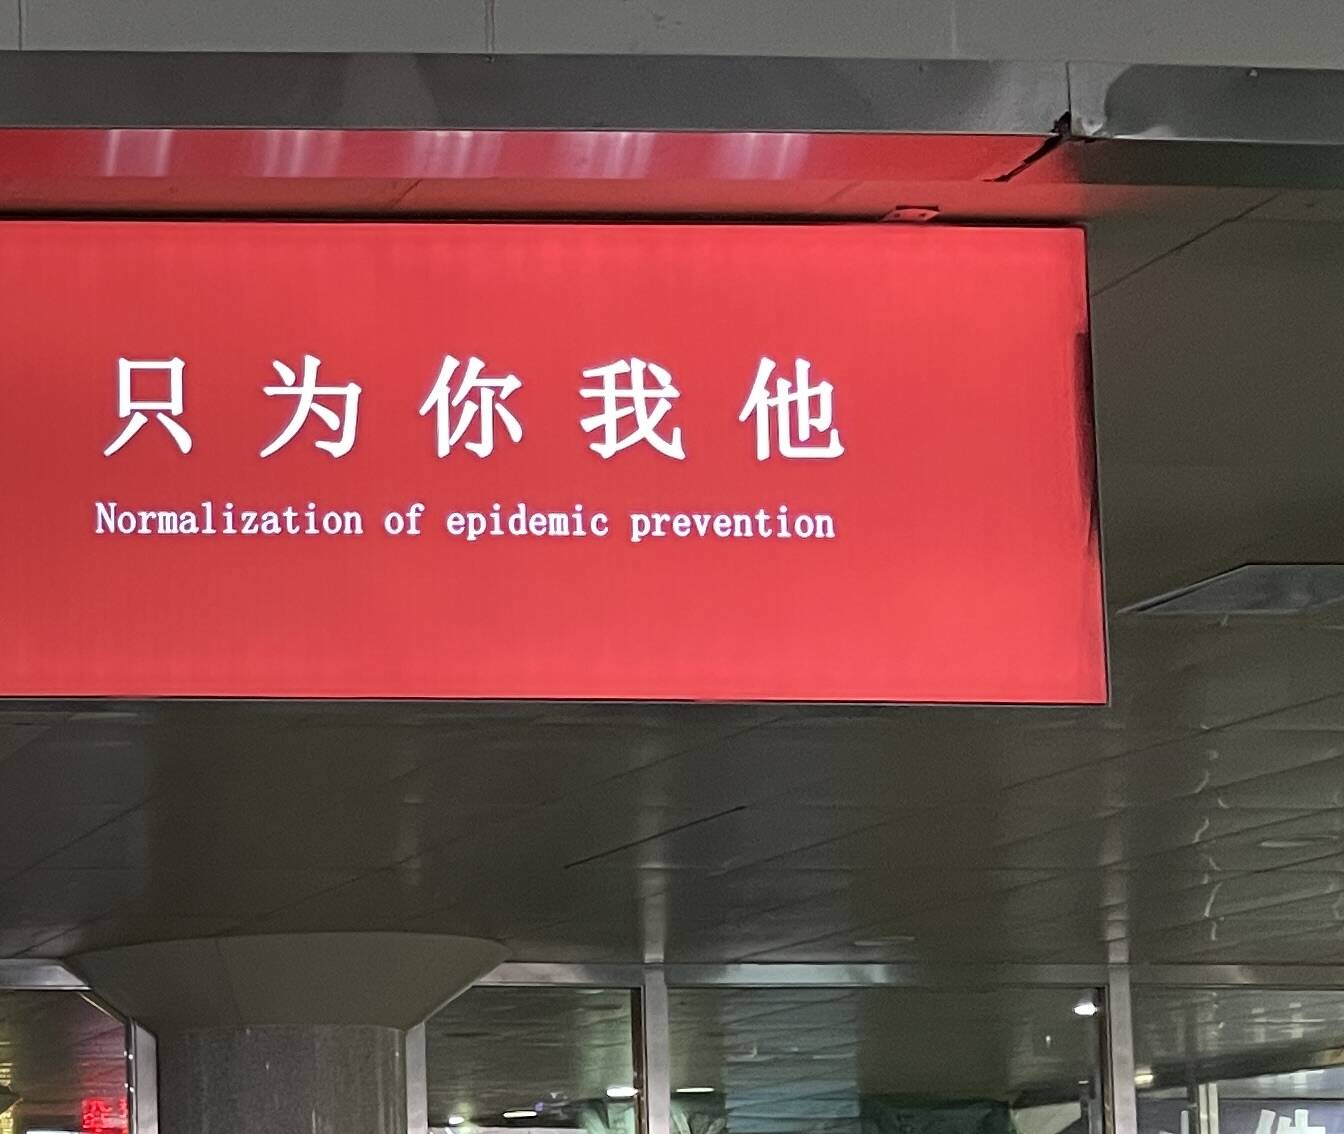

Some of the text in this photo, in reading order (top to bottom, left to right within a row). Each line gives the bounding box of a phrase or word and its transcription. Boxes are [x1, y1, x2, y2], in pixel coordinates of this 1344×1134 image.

[102, 353, 846, 463] 只为你我他
[94, 500, 837, 543] Normalization of epidemic prevention
